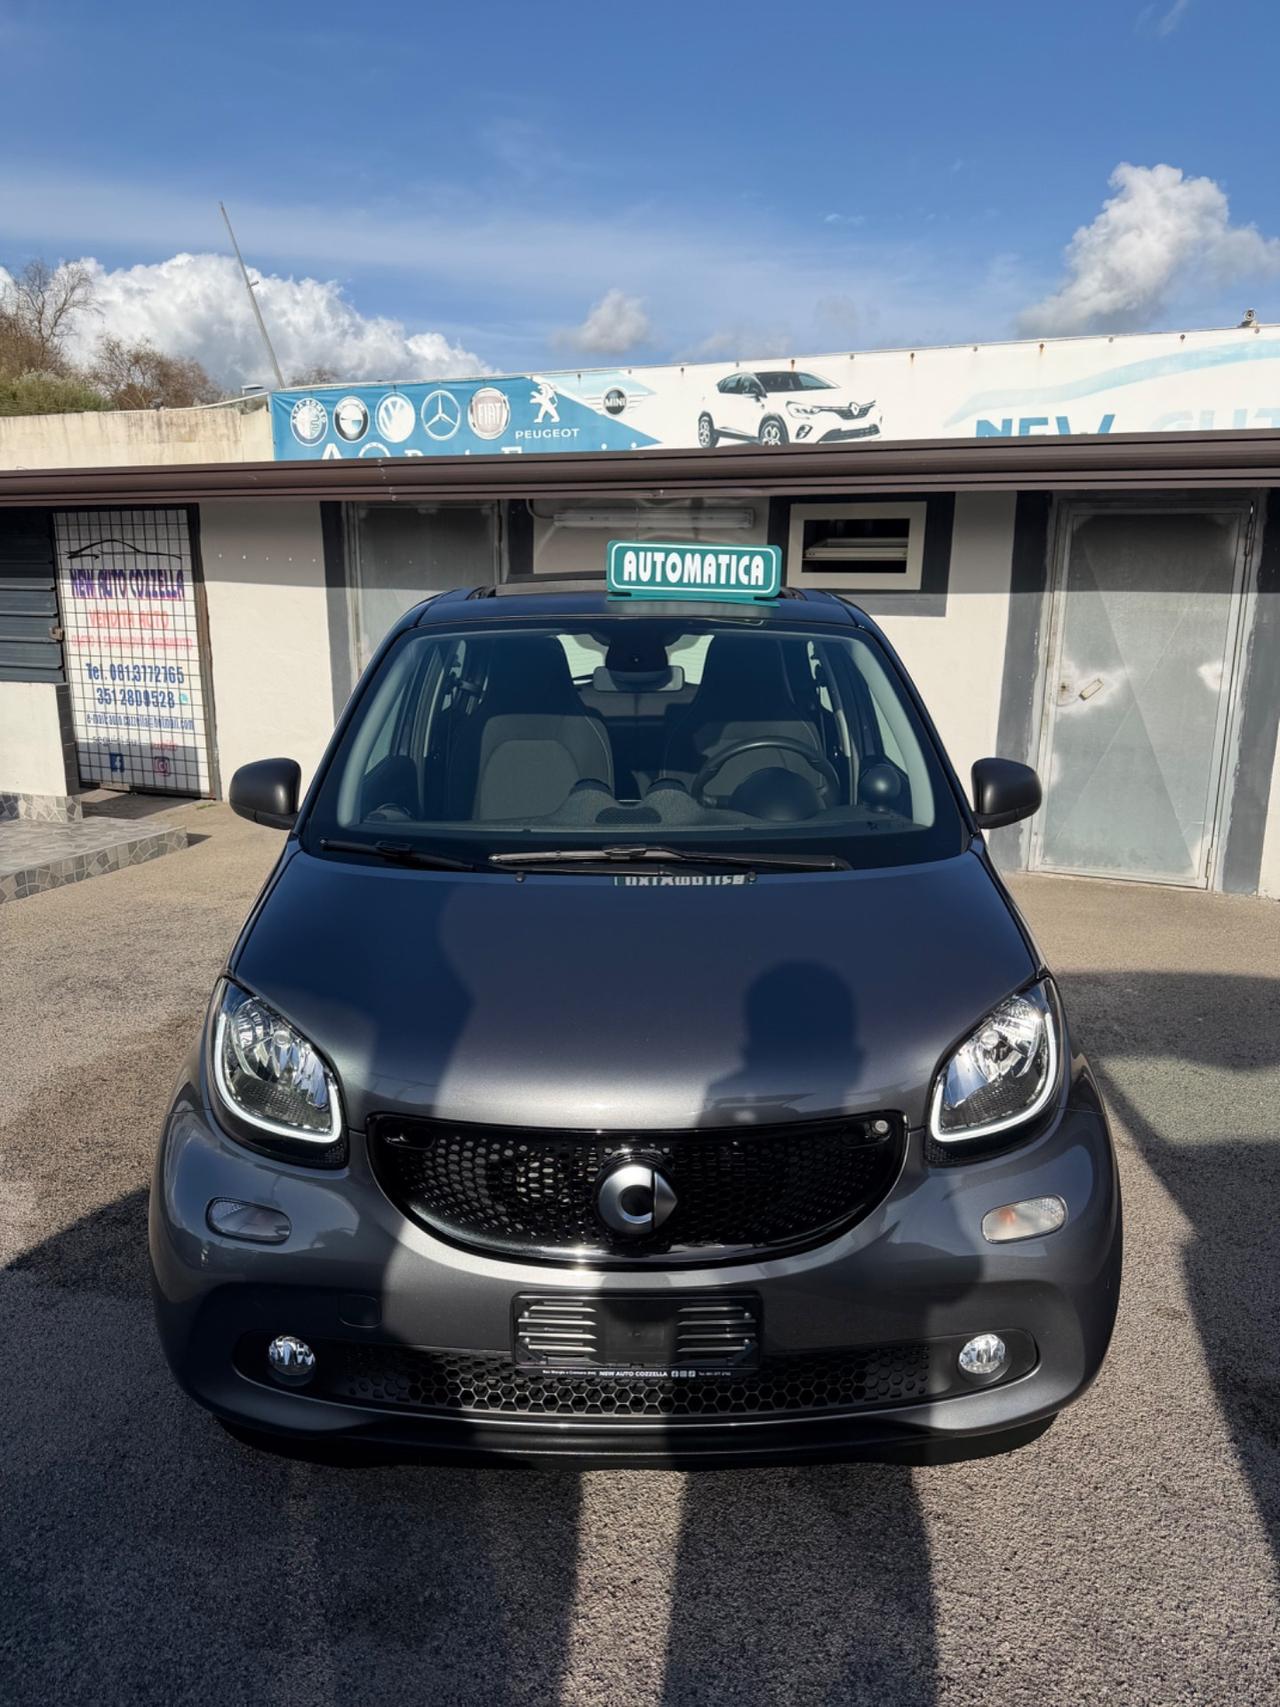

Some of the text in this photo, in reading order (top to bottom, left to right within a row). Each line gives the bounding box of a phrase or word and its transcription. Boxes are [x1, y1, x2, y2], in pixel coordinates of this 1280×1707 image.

[605, 397, 626, 408] MINI
[477, 402, 501, 424] FIAT
[515, 427, 580, 440] PEUGEOT
[623, 550, 765, 586] AUTOMATICA
[69, 569, 185, 600] NEW AUTO COZZELLA
[88, 609, 169, 629] VENDITA AUTO
[96, 687, 117, 705] 351
